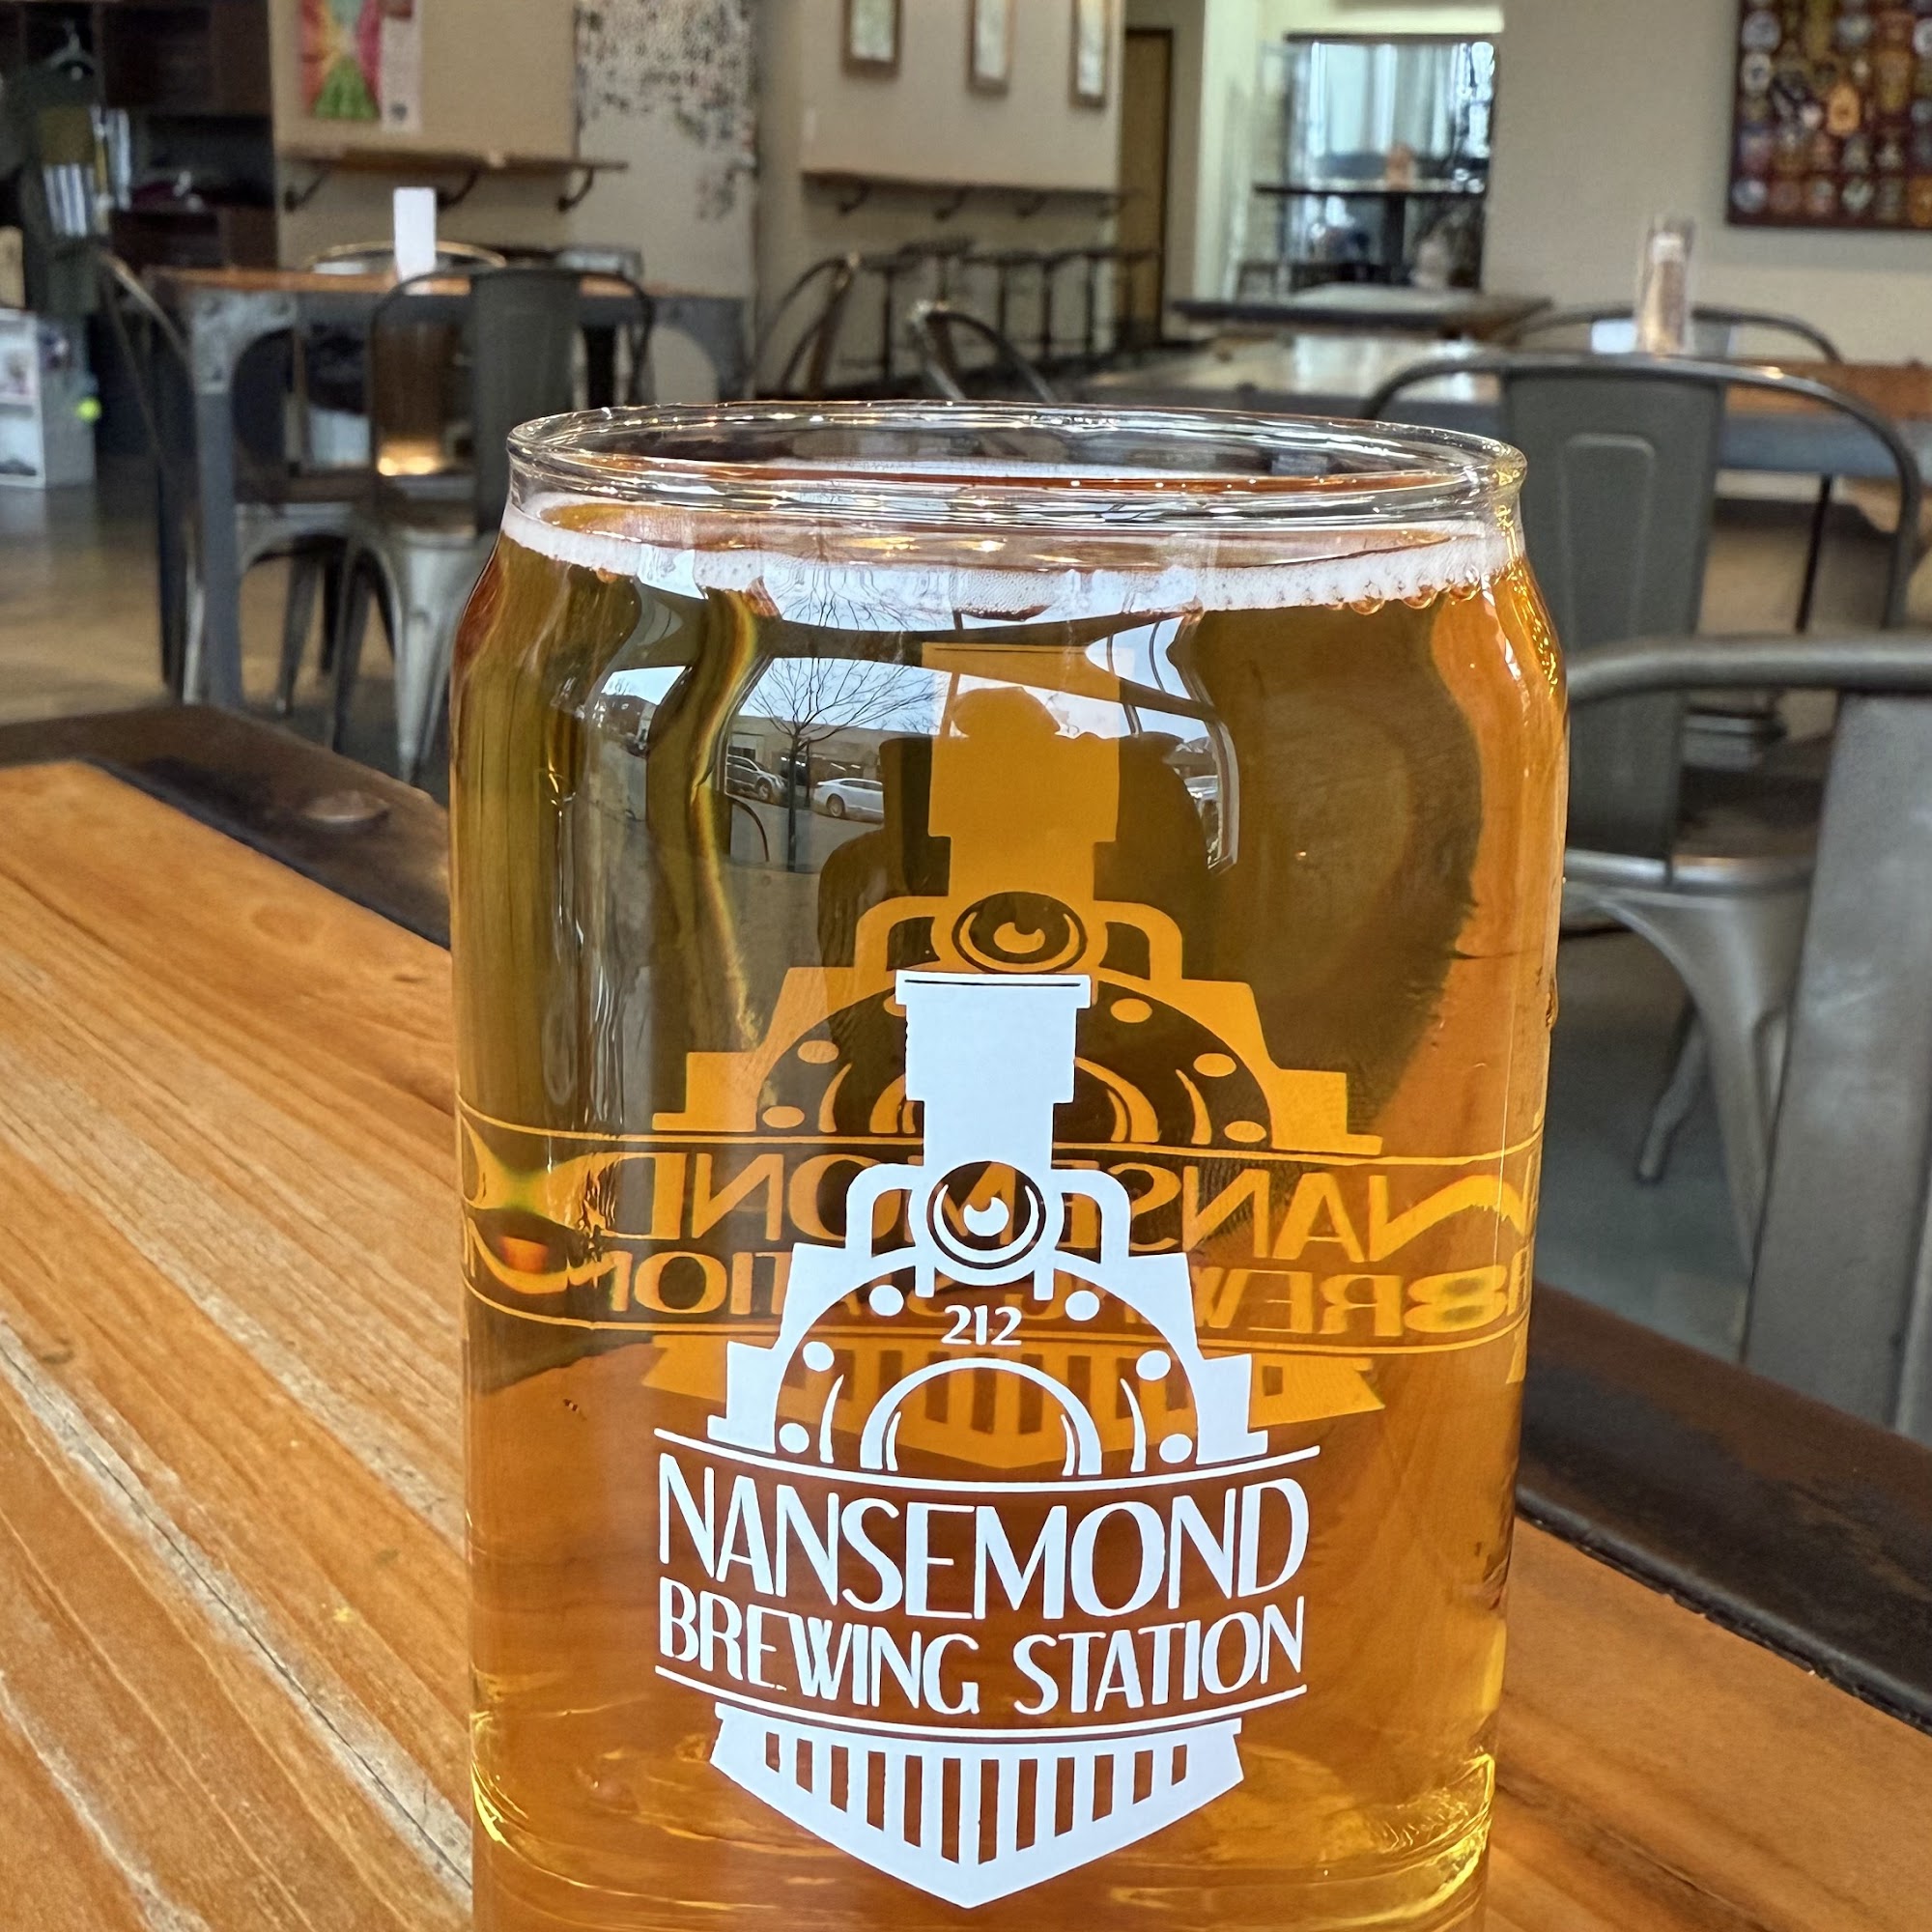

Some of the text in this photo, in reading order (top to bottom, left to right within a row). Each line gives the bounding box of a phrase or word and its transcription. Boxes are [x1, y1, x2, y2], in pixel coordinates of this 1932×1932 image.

[942, 1305, 1023, 1347] 212
[659, 1452, 1310, 1620] NANSEMOND
[659, 1577, 1305, 1716] BREWING STATION
